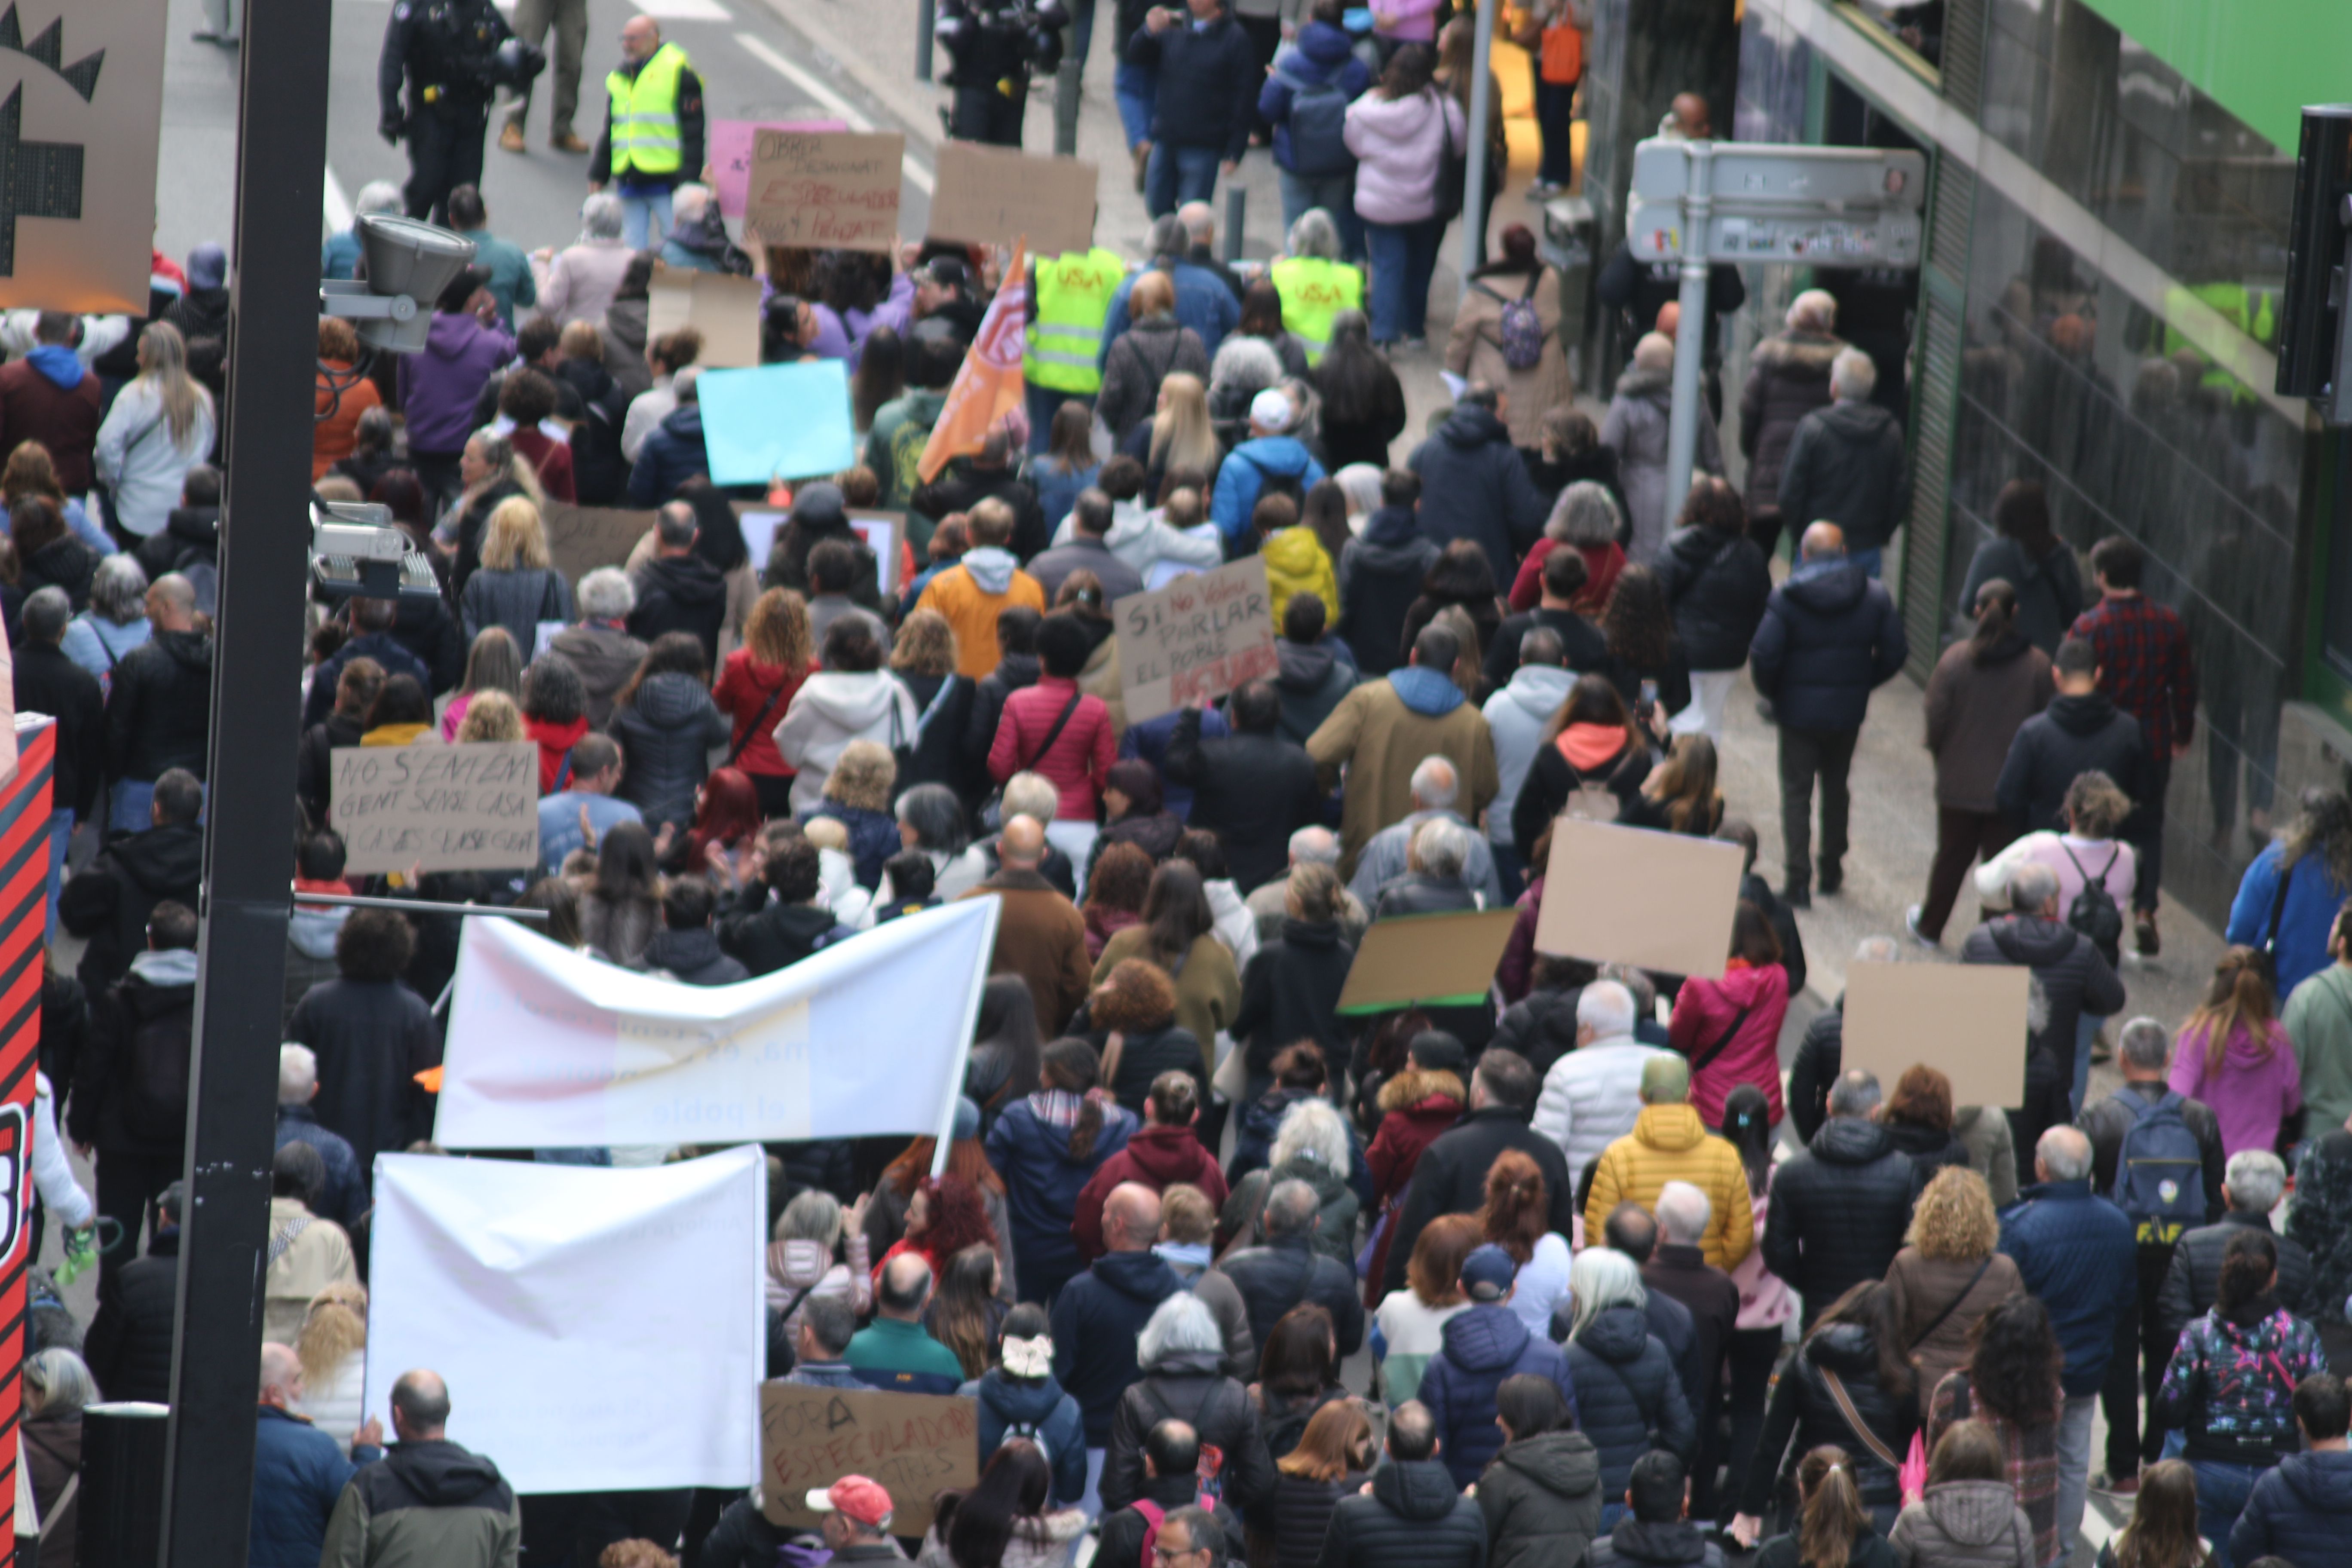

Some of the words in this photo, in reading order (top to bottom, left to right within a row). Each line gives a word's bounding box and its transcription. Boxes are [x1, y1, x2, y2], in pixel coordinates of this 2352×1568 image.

[757, 134, 822, 162] OBRER
[1158, 593, 1265, 649] PARLAR
[1136, 662, 1161, 686] EL
[1170, 636, 1228, 672] POBLE
[340, 757, 379, 788] NO
[340, 790, 404, 817] GENT
[407, 787, 470, 813] SENSE
[476, 790, 526, 818] CASA
[761, 1395, 858, 1444] FORA
